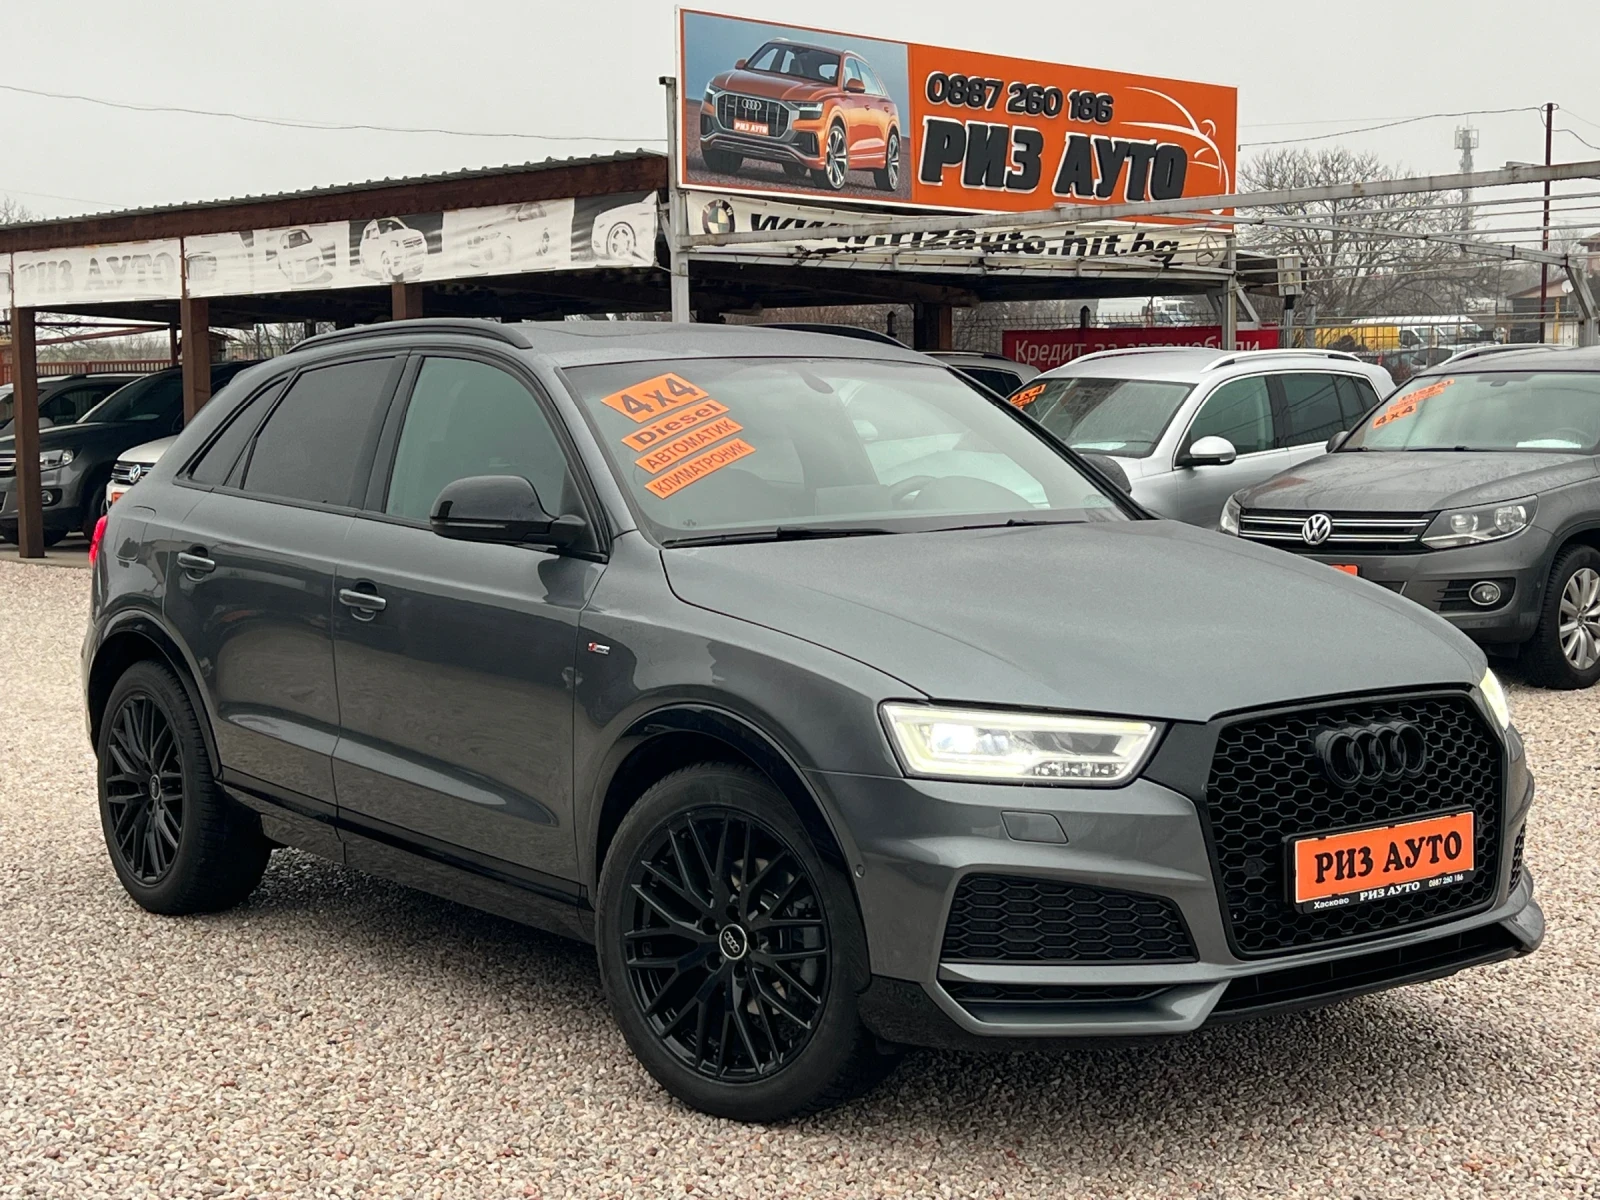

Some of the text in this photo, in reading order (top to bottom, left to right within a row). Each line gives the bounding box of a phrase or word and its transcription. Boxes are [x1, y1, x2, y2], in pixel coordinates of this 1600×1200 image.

[926, 71, 1114, 123] 0887 260 186
[919, 115, 1188, 202] РИЗ АУТО
[751, 213, 1181, 266] w.izauto.hit.bg
[1015, 340, 1087, 363] Кредит
[620, 377, 698, 415] 4x4
[632, 403, 721, 445] Diesel
[645, 420, 737, 470] АВТОМАТИК
[653, 442, 746, 494] КЛИМАТРОНИК
[1315, 831, 1462, 884] РИЗ АУТО
[1313, 897, 1350, 910] Хасково
[1359, 888, 1385, 902] РИЗ
[1387, 881, 1421, 897] АУТО
